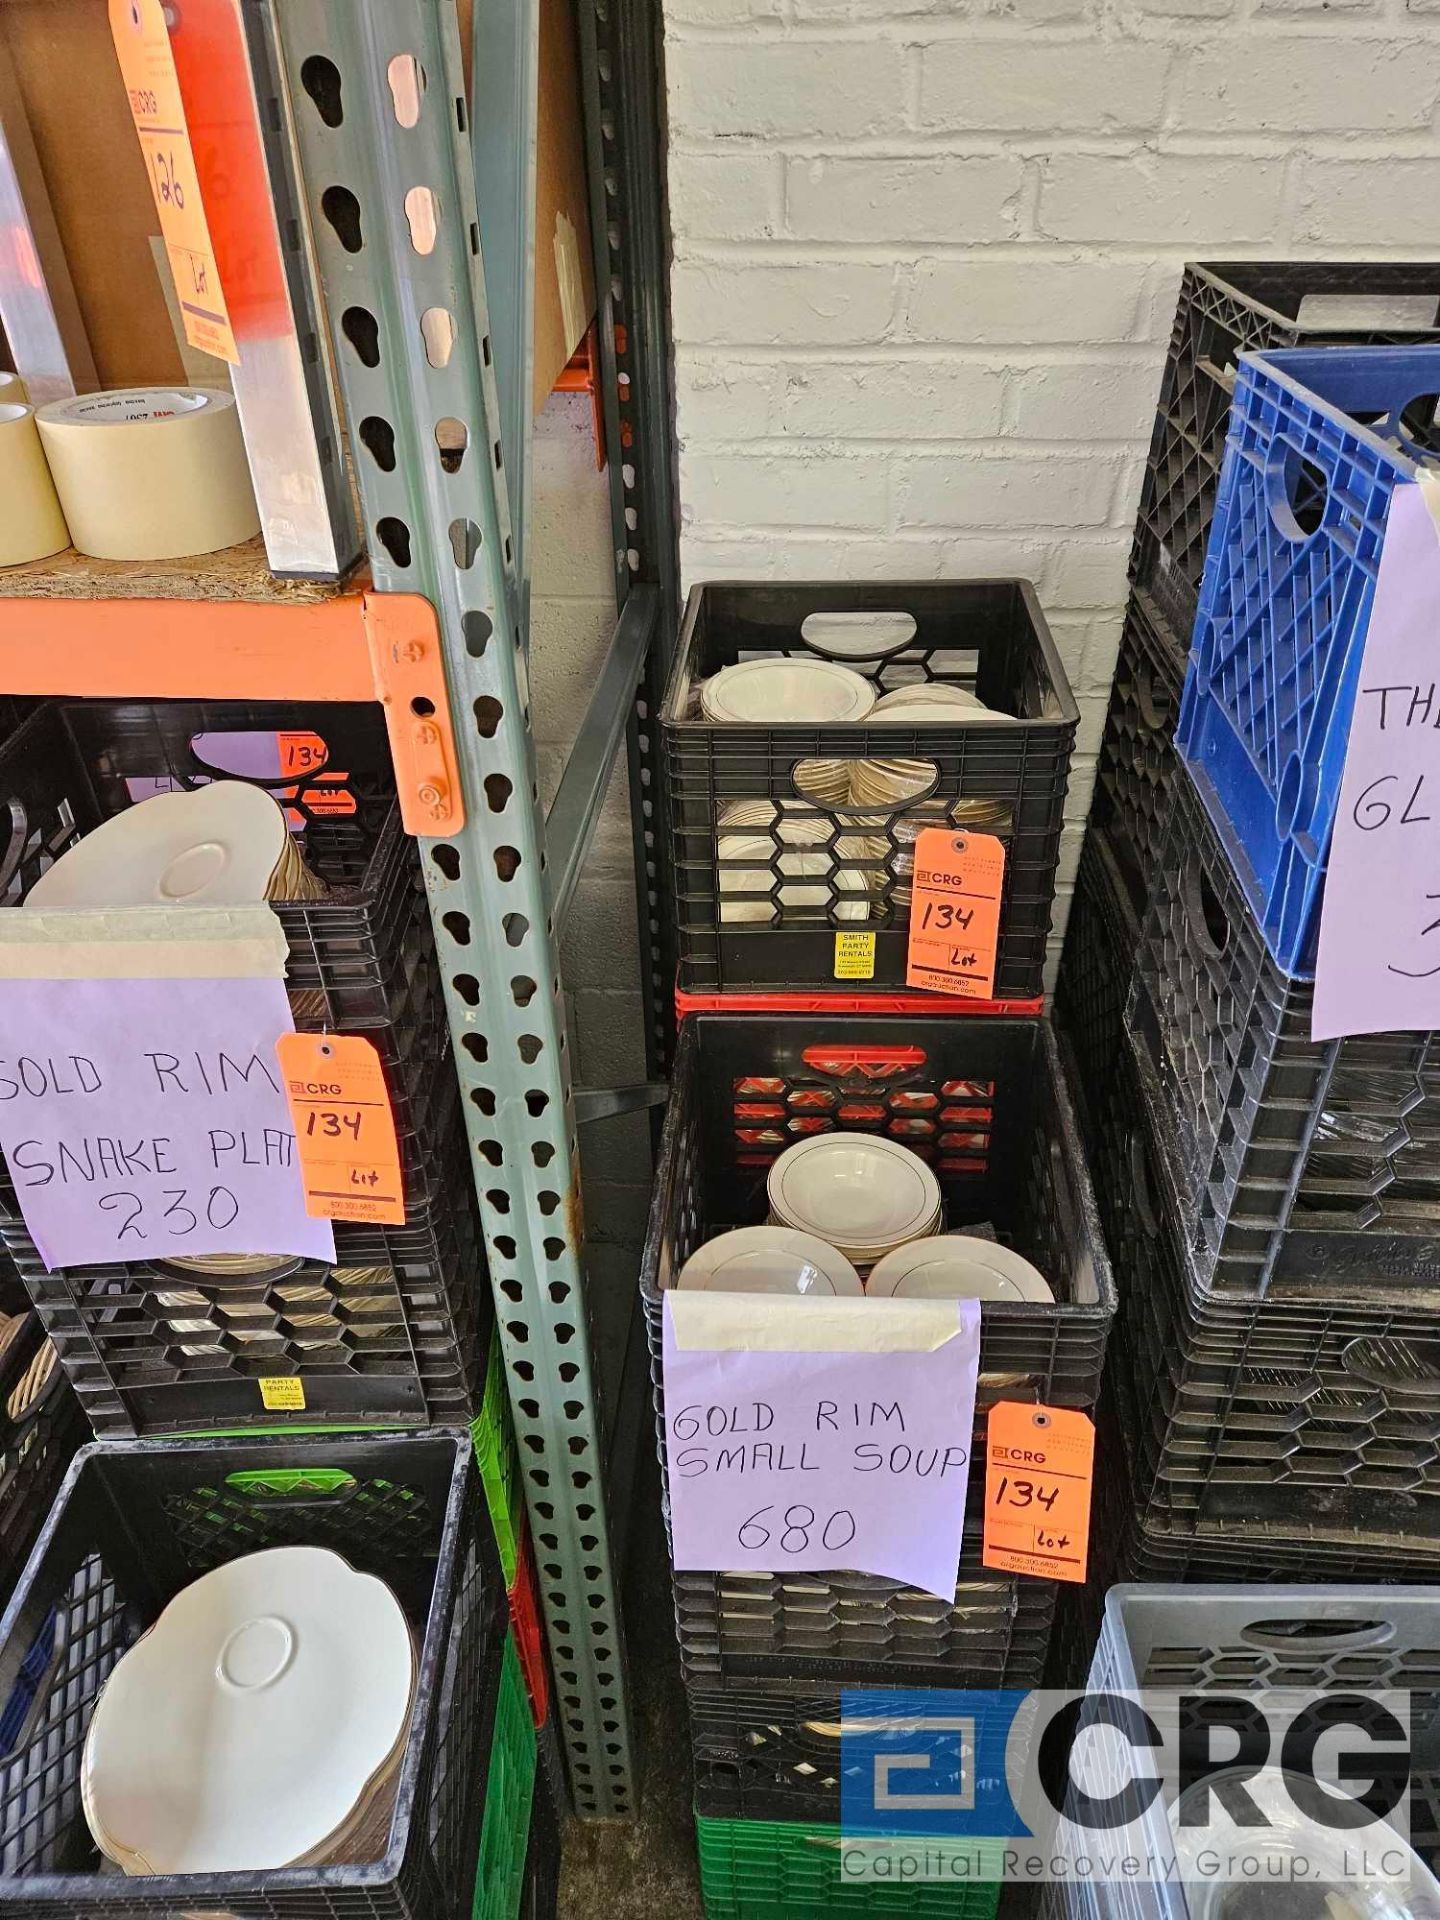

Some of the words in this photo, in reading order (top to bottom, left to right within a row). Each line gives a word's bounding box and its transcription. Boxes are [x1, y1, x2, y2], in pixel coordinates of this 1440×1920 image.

[138, 90, 157, 114] CRG
[149, 151, 184, 209] 126
[1363, 683, 1440, 730] TH
[288, 746, 327, 767] 134
[931, 872, 962, 886] CRG
[921, 902, 974, 931] 134
[950, 947, 977, 967] Lot
[144, 1051, 280, 1095] RIM
[306, 1083, 342, 1096] CRG
[306, 1112, 363, 1141] 134
[13, 1138, 177, 1187] SNAKE
[99, 1186, 239, 1240] 230
[673, 1402, 774, 1441] GOLD
[817, 1400, 905, 1432] RIM
[677, 1442, 820, 1479] SMALL
[853, 1443, 967, 1478] SOUP
[1010, 1449, 1046, 1463] CRG
[995, 1476, 1060, 1512] 134
[738, 1504, 856, 1554] 680
[1037, 1531, 1070, 1549] Lot
